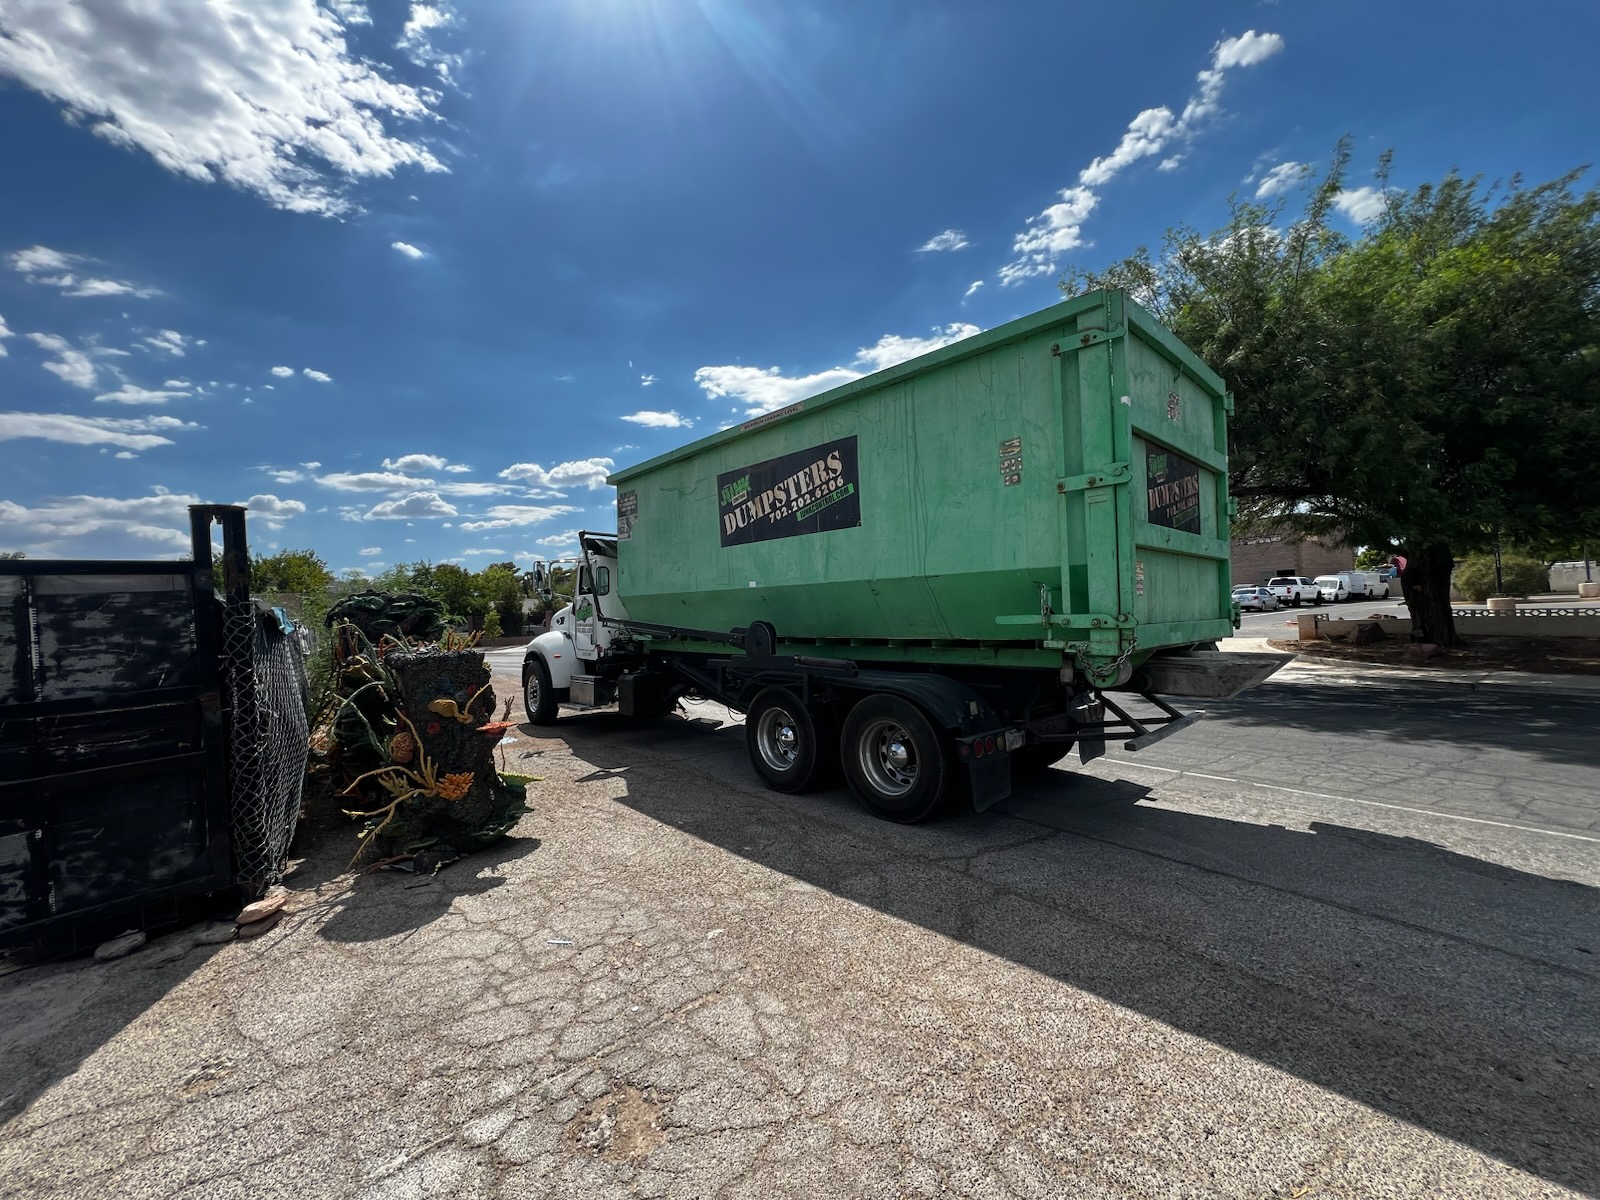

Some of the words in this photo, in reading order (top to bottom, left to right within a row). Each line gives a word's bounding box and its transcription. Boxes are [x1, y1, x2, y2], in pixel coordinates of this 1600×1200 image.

[720, 474, 752, 507] JUNK
[723, 449, 843, 536] DUMPSTERS
[768, 475, 844, 524] 702.202.6206
[1148, 474, 1199, 512] DUMPSTERS
